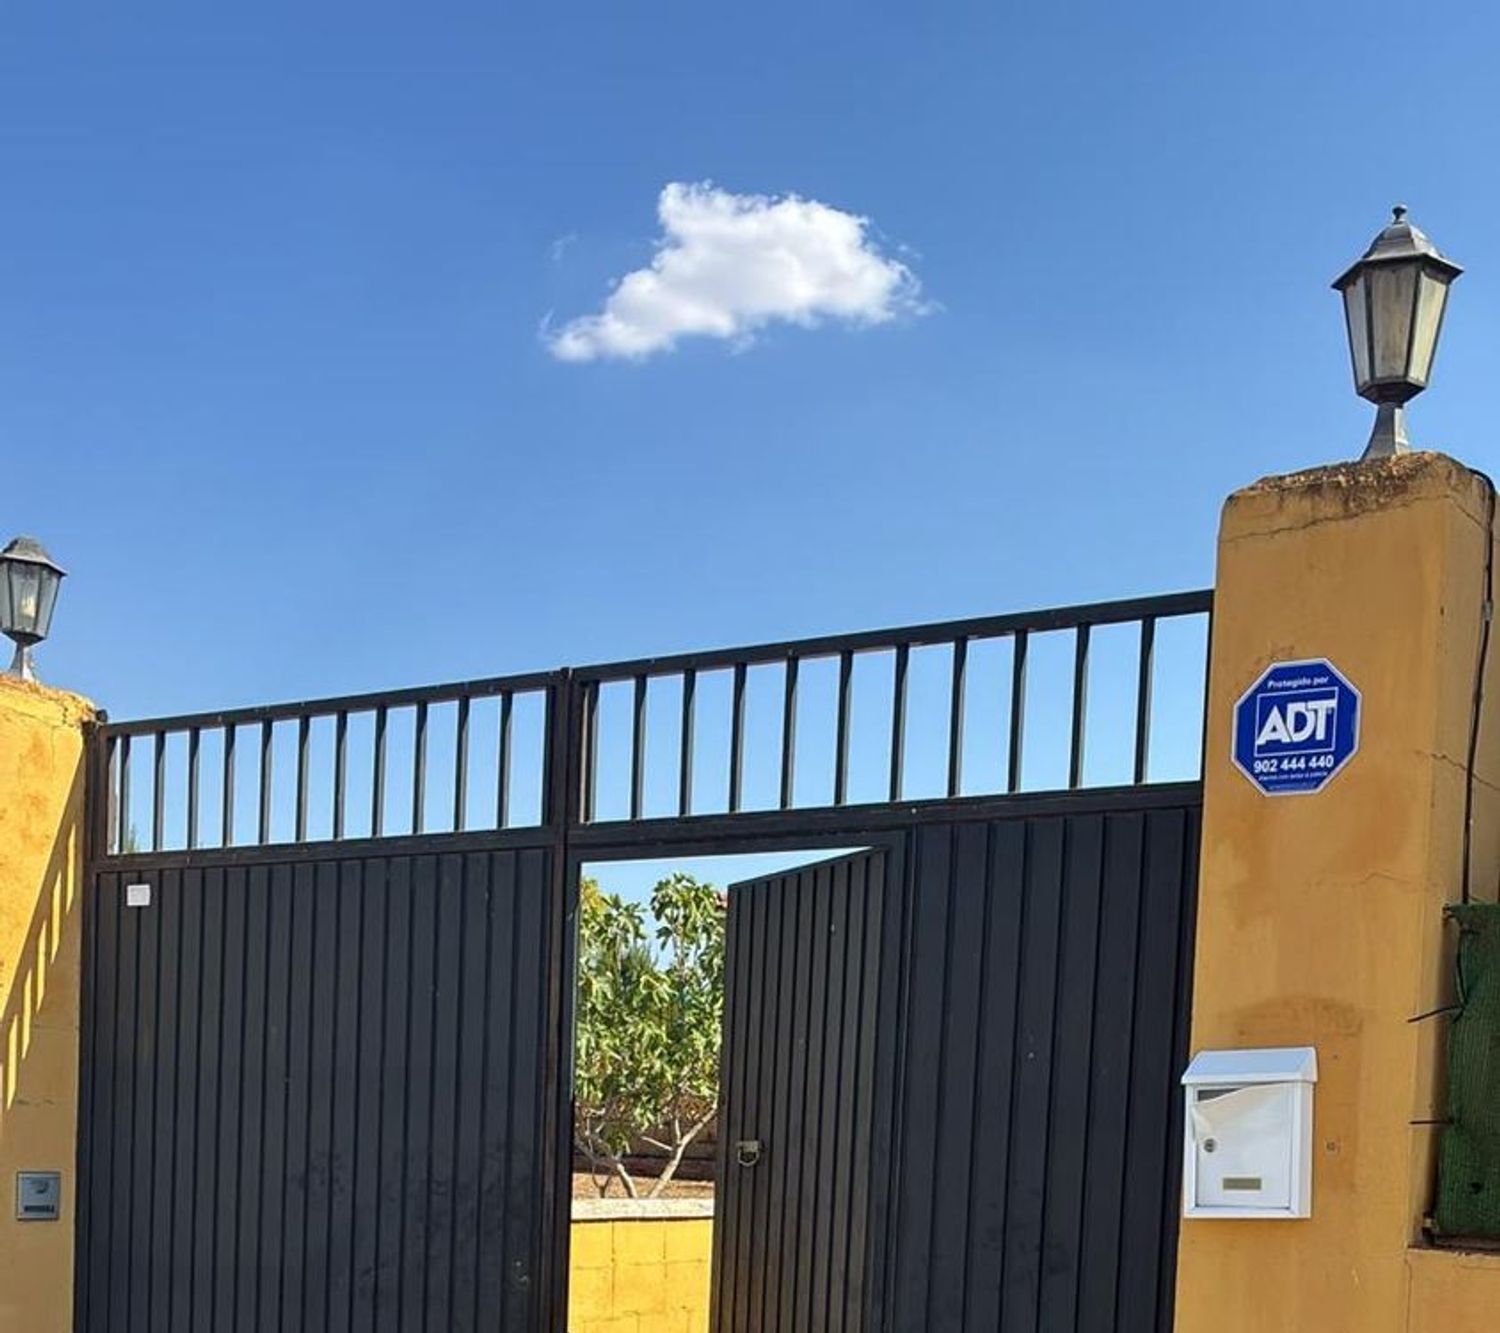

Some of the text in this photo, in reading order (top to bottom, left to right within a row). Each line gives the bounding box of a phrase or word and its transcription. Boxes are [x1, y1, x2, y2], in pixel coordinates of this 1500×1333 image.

[1313, 676, 1329, 686] por
[1256, 698, 1337, 746] ADT
[1253, 754, 1335, 774] 902 444 440
